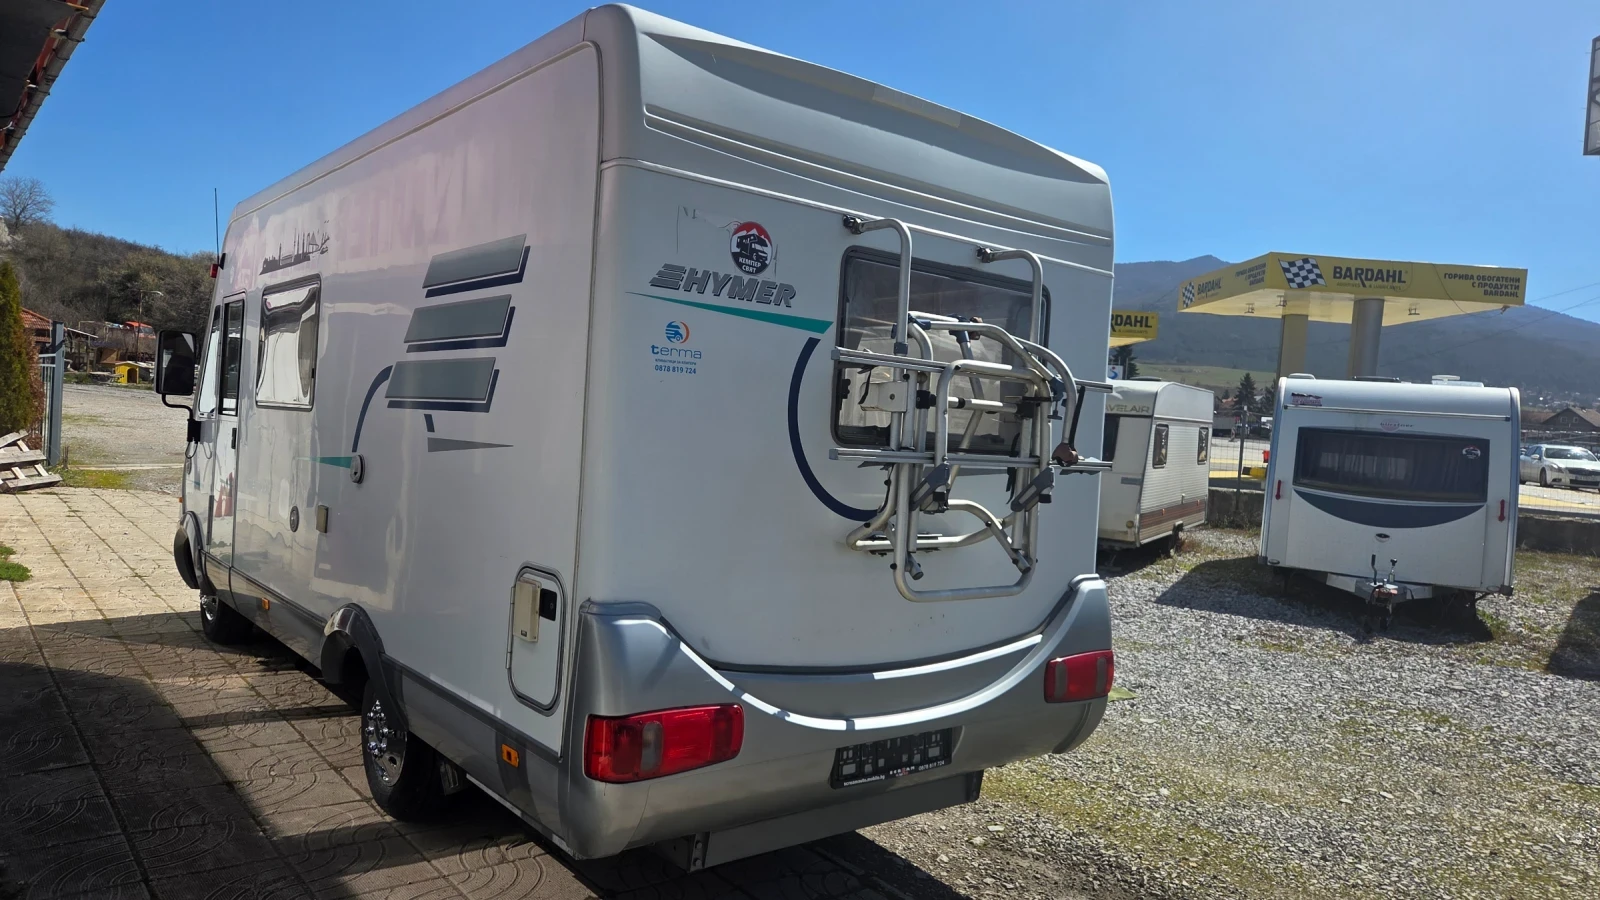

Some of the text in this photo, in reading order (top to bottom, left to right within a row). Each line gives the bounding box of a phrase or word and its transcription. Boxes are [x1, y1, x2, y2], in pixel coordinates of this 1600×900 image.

[738, 257, 761, 268] КЕМПЕР
[742, 264, 756, 274] СВЯТ
[1333, 265, 1405, 288] BARDAHL
[1443, 272, 1520, 284] ГОРИВА ОБОГАТЕНИ
[683, 267, 796, 308] HYMER
[1197, 276, 1221, 298] BARDAHL
[1477, 282, 1519, 290] ПРОДУКТИ
[1483, 289, 1518, 298] BARDAHL
[650, 344, 702, 360] terma
[654, 364, 670, 372] 0878
[671, 365, 683, 374] 819
